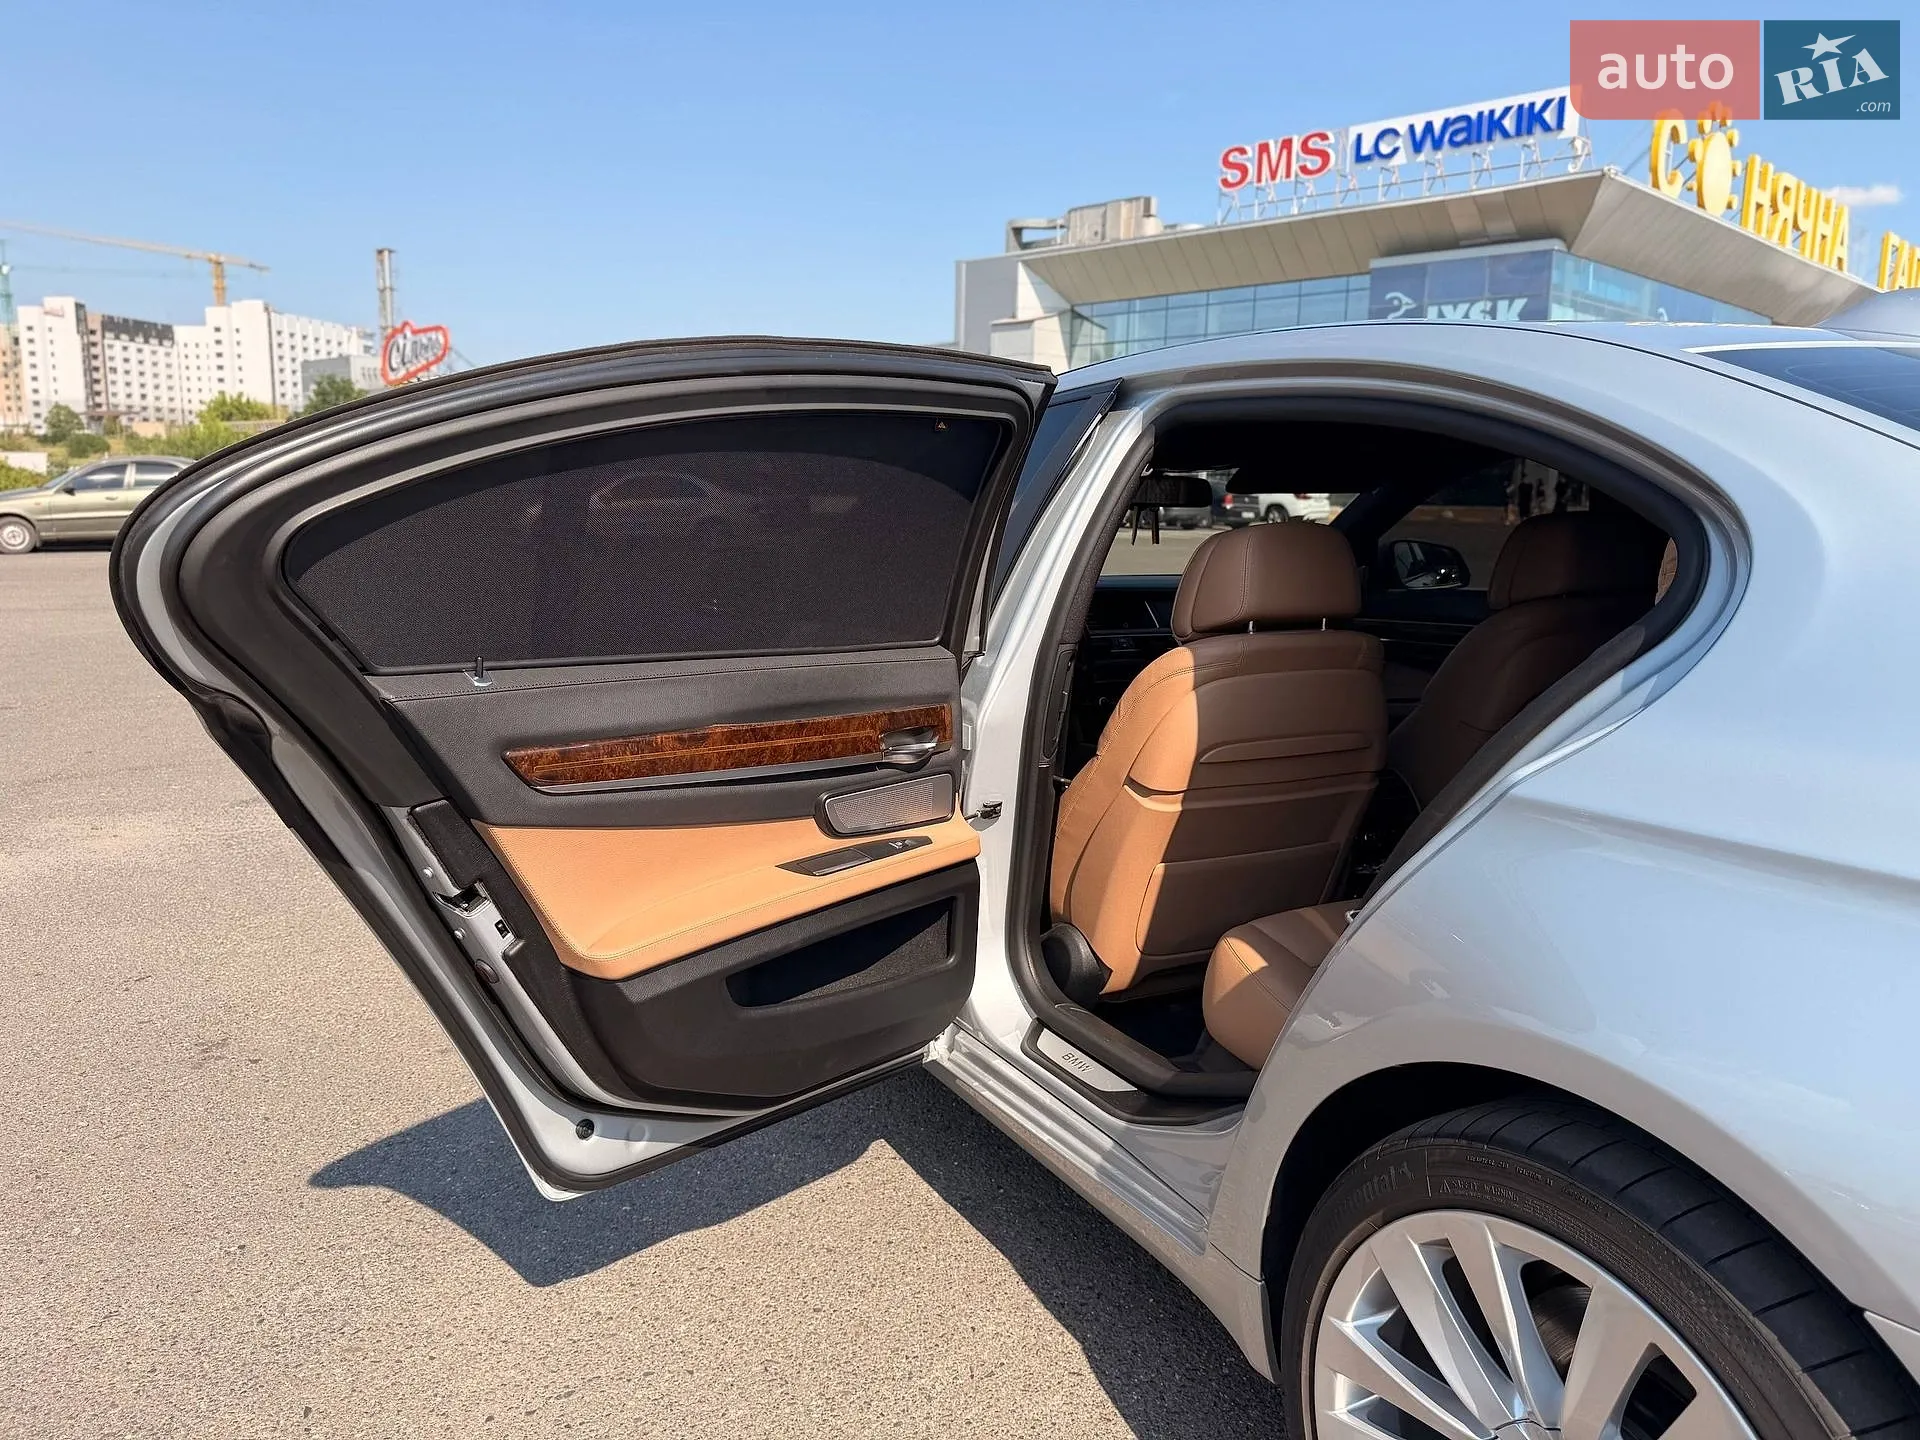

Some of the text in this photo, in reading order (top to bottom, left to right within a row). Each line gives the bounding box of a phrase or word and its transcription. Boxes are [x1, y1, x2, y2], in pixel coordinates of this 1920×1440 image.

[1219, 131, 1333, 190] SMS
[1355, 127, 1401, 164] LC
[1062, 1052, 1094, 1073] BMW
